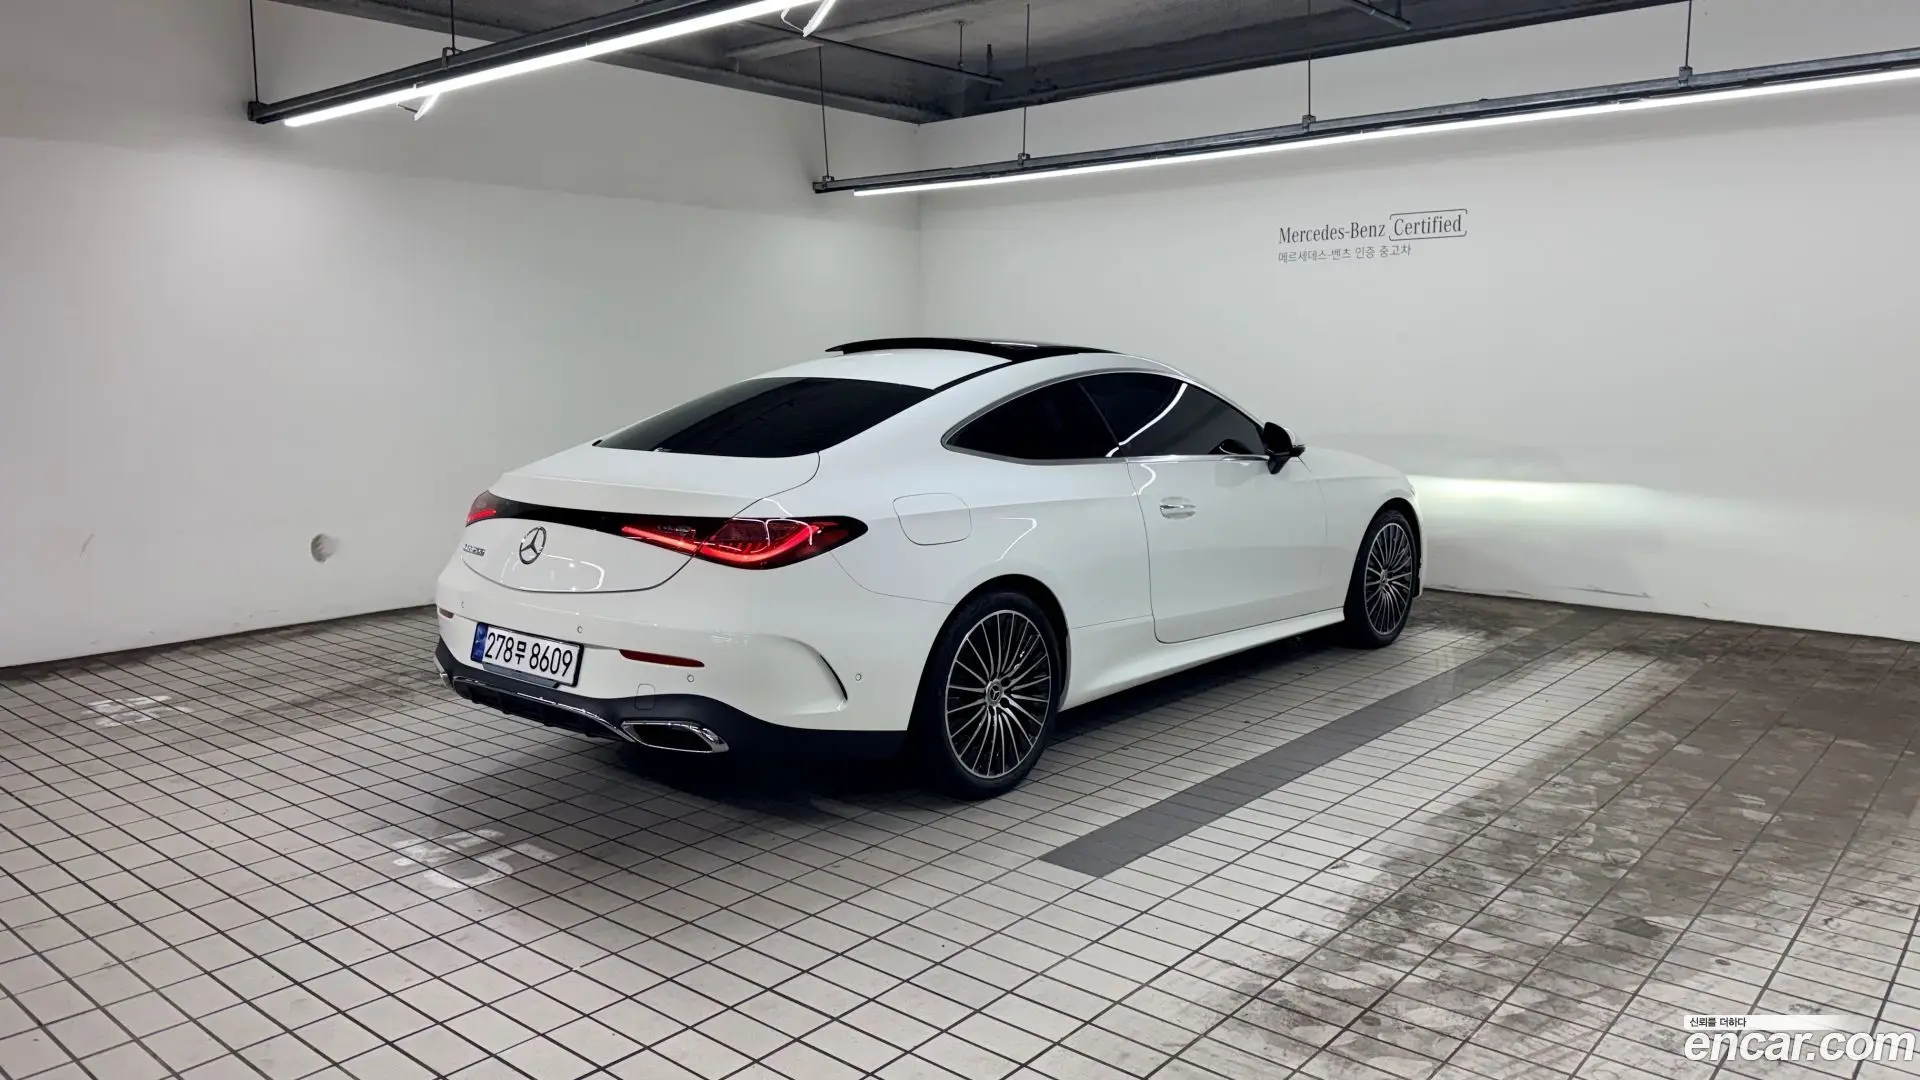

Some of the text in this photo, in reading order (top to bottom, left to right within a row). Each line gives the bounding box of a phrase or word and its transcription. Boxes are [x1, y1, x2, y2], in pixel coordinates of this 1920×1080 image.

[1279, 214, 1462, 244] Mercedes-Benz Certified
[1278, 244, 1412, 264] 메르세데스-벤츠 인증 중고차
[485, 632, 573, 677] 278무 8609
